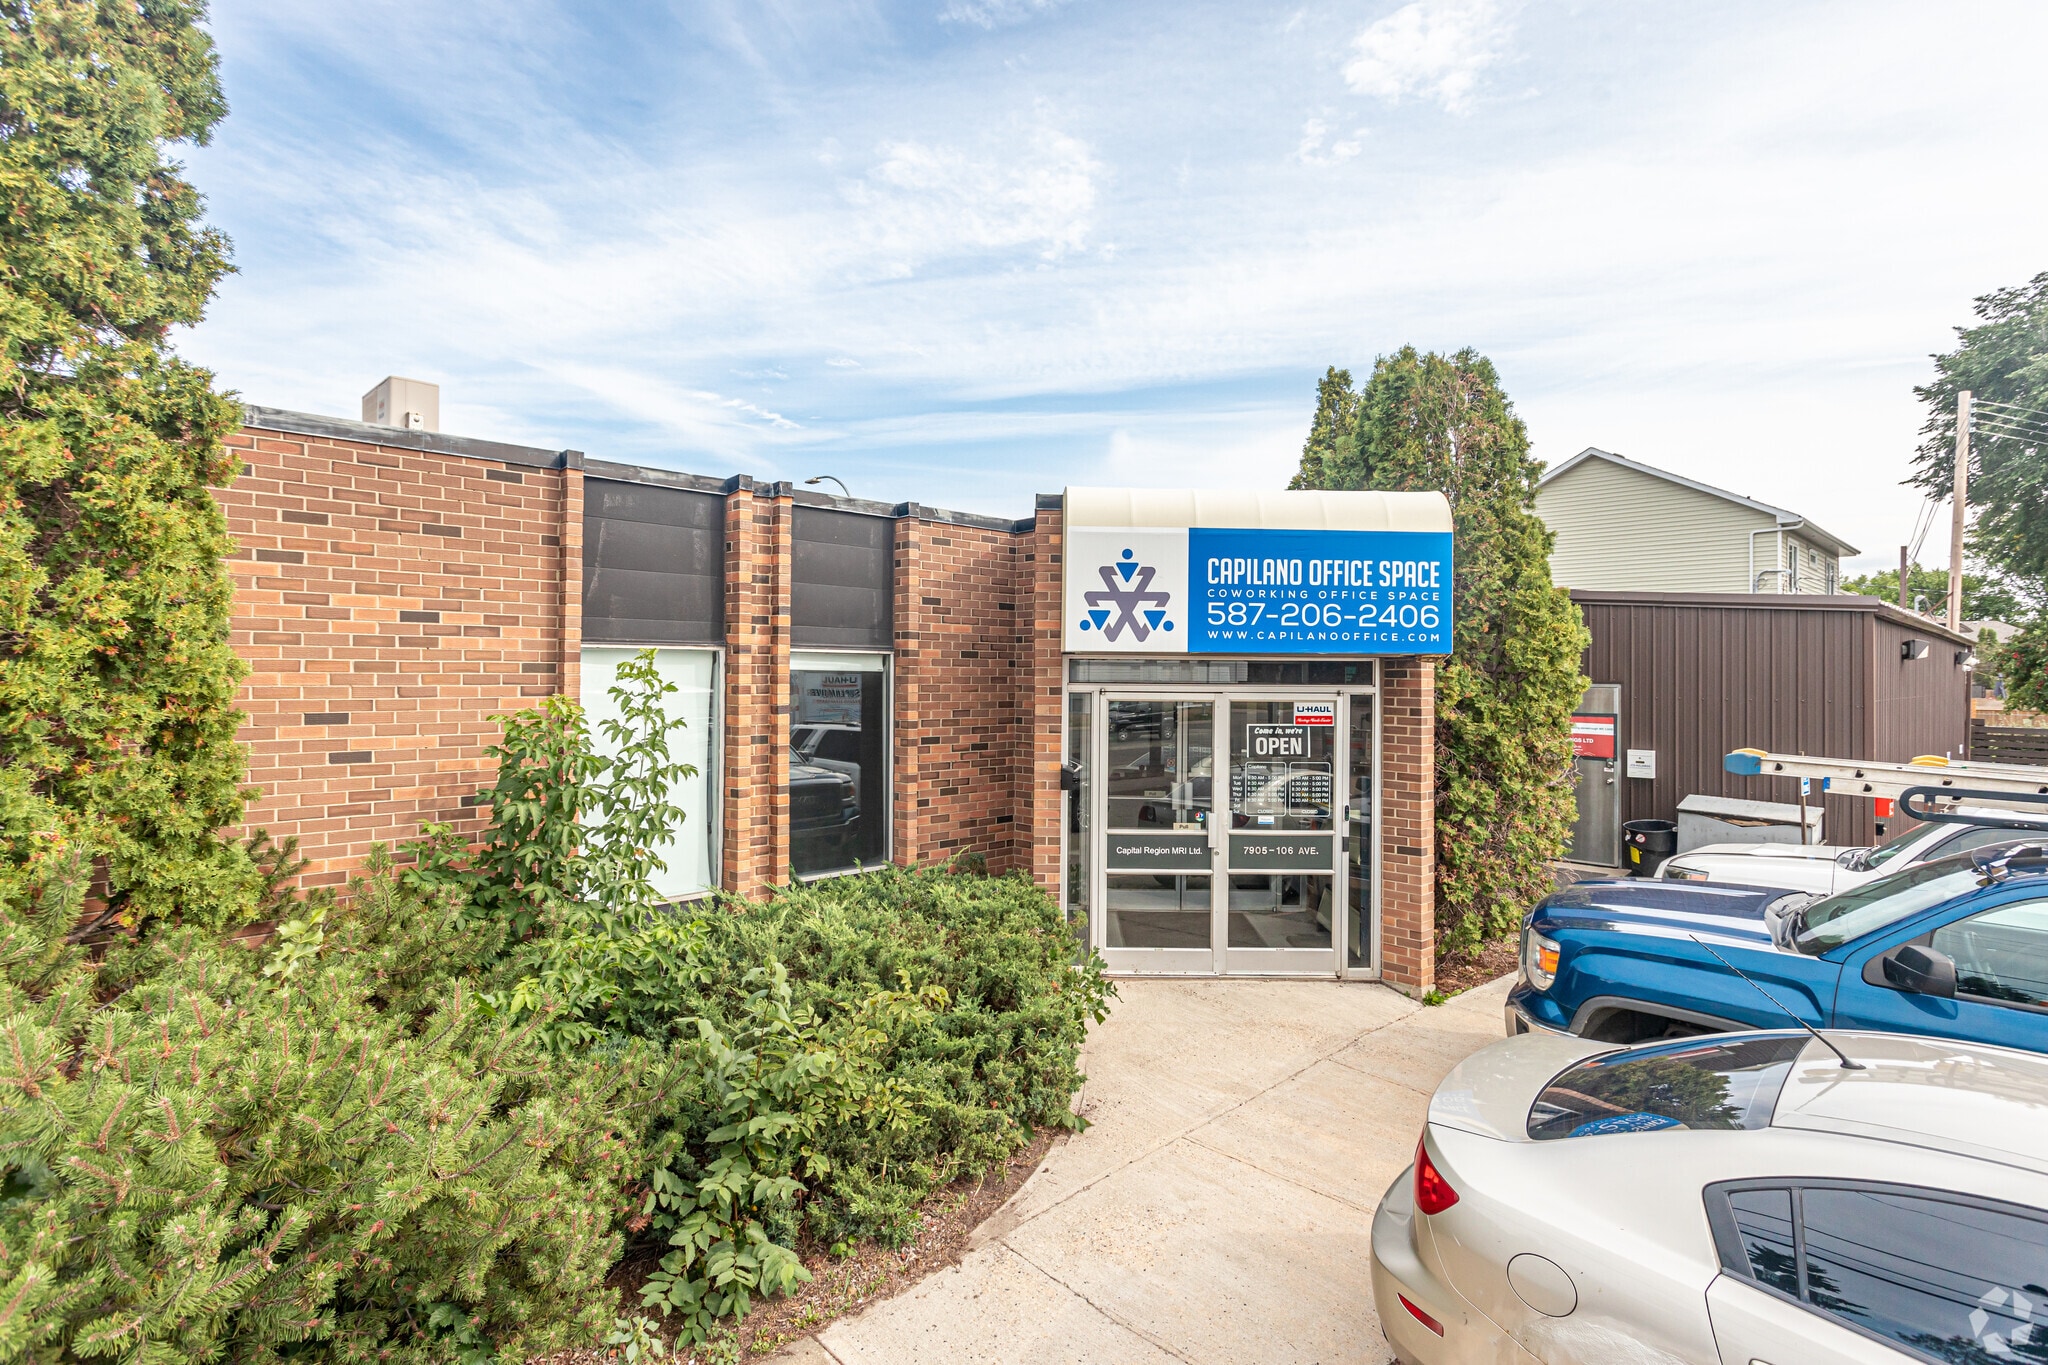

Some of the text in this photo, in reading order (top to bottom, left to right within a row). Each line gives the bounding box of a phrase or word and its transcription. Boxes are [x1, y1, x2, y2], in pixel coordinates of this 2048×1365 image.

[1208, 558, 1440, 588] CAPILANO OFFICE SPACE
[1208, 589, 1440, 601] COWORKING OFFICE SPACE
[1208, 602, 1440, 628] 587-206-2406
[1208, 631, 1440, 643] WWW.CAPILANOOFFICE.COM
[1255, 737, 1302, 755] OPEN
[1116, 847, 1142, 855] Capital
[1144, 847, 1170, 856] Region
[1189, 847, 1202, 855] Ltd.
[1243, 846, 1319, 855] 7905-106 AVE.
